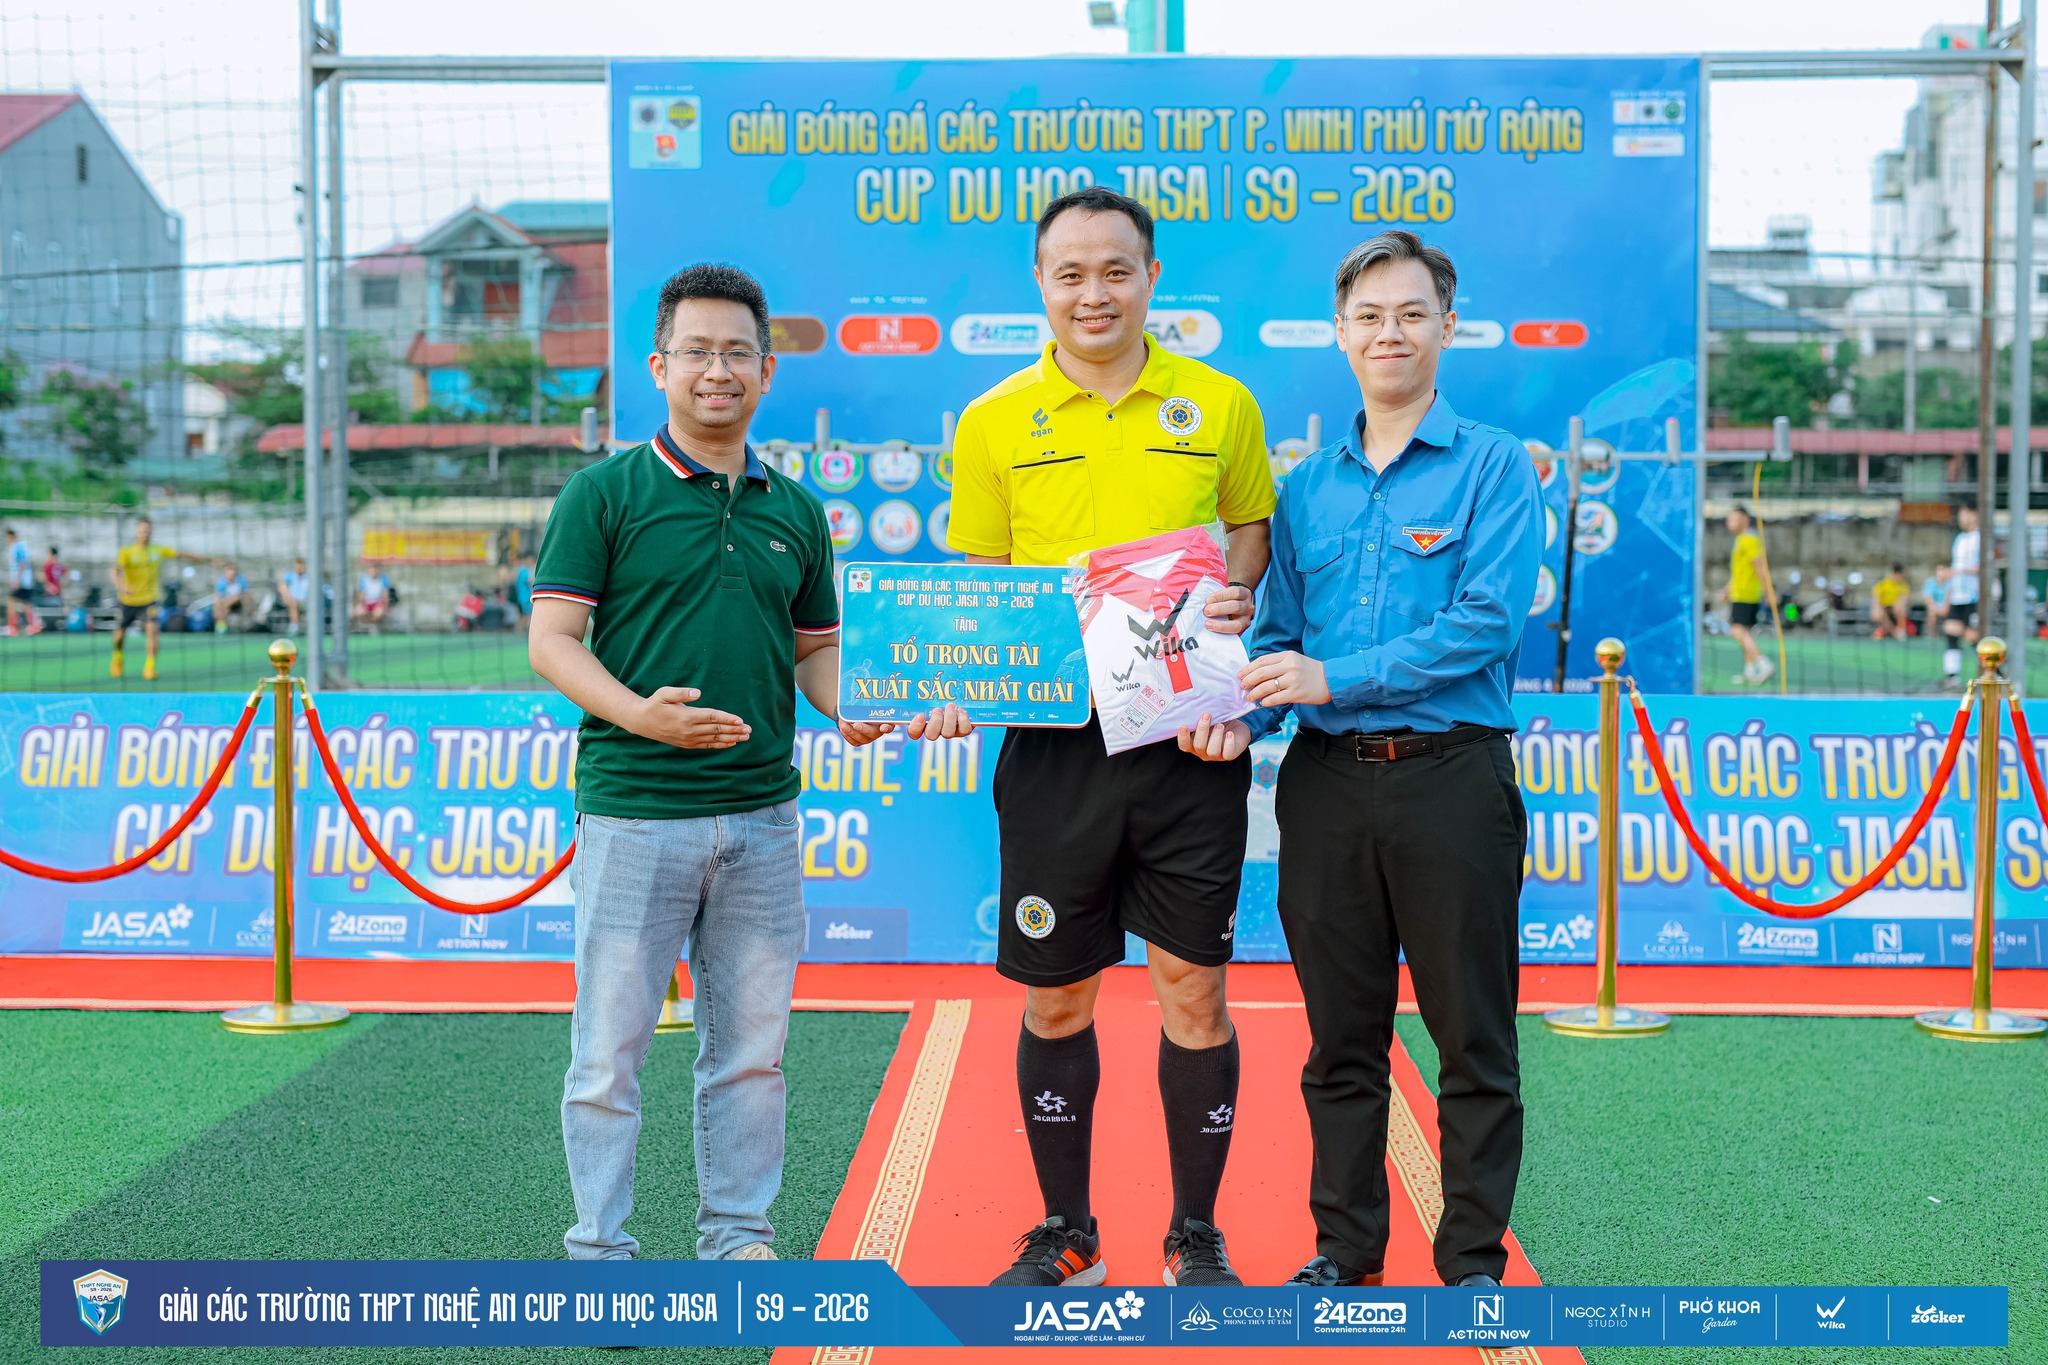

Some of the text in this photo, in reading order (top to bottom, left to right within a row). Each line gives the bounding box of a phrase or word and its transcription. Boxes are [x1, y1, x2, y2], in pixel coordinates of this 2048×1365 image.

[729, 98, 1584, 162] GIẢI BÓNG ĐÁ CÁC TRƯỜNG THPT P. VINH PHÚ MỞ RỘNG
[855, 166, 935, 223] CUP
[949, 166, 1001, 223] DU
[1244, 165, 1298, 223] S9
[1351, 164, 1456, 223] 2026
[1030, 427, 1053, 438] egan
[878, 577, 1053, 594] GIẢI BÓNG ĐÁ CÁC TRƯỜNG THPT NGHỆ AN
[897, 594, 916, 606] CUP
[918, 594, 931, 607] DU
[933, 594, 952, 609] HỌC
[955, 594, 978, 607] JASA
[986, 595, 999, 608] S9
[1010, 595, 1034, 608] 2026
[889, 635, 1040, 669] TỔ TRỌNG TÀI
[1134, 636, 1199, 661] Wika
[855, 671, 1074, 703] XUẤT SẮC NHẤT GIẢI
[1116, 682, 1141, 693] Wika
[869, 709, 891, 717] JASA
[20, 714, 106, 788] GIẢI
[326, 716, 414, 790] CÁC
[432, 716, 577, 790] TRƯỜ
[919, 732, 979, 793] AN
[1628, 721, 1692, 796] ĐÁ
[1708, 722, 1798, 798] CÁC
[113, 804, 214, 873] CUP
[312, 806, 414, 889] HỌC
[431, 806, 557, 875] JASA
[798, 808, 869, 878] 26
[1621, 812, 1689, 883] DU
[1708, 814, 1810, 899] HỌC
[1830, 816, 1962, 888] JASA
[2006, 817, 2048, 888] S
[82, 911, 172, 939] JASA
[437, 939, 509, 950] ACTION NOW
[1853, 952, 1926, 965] ACTION NOW
